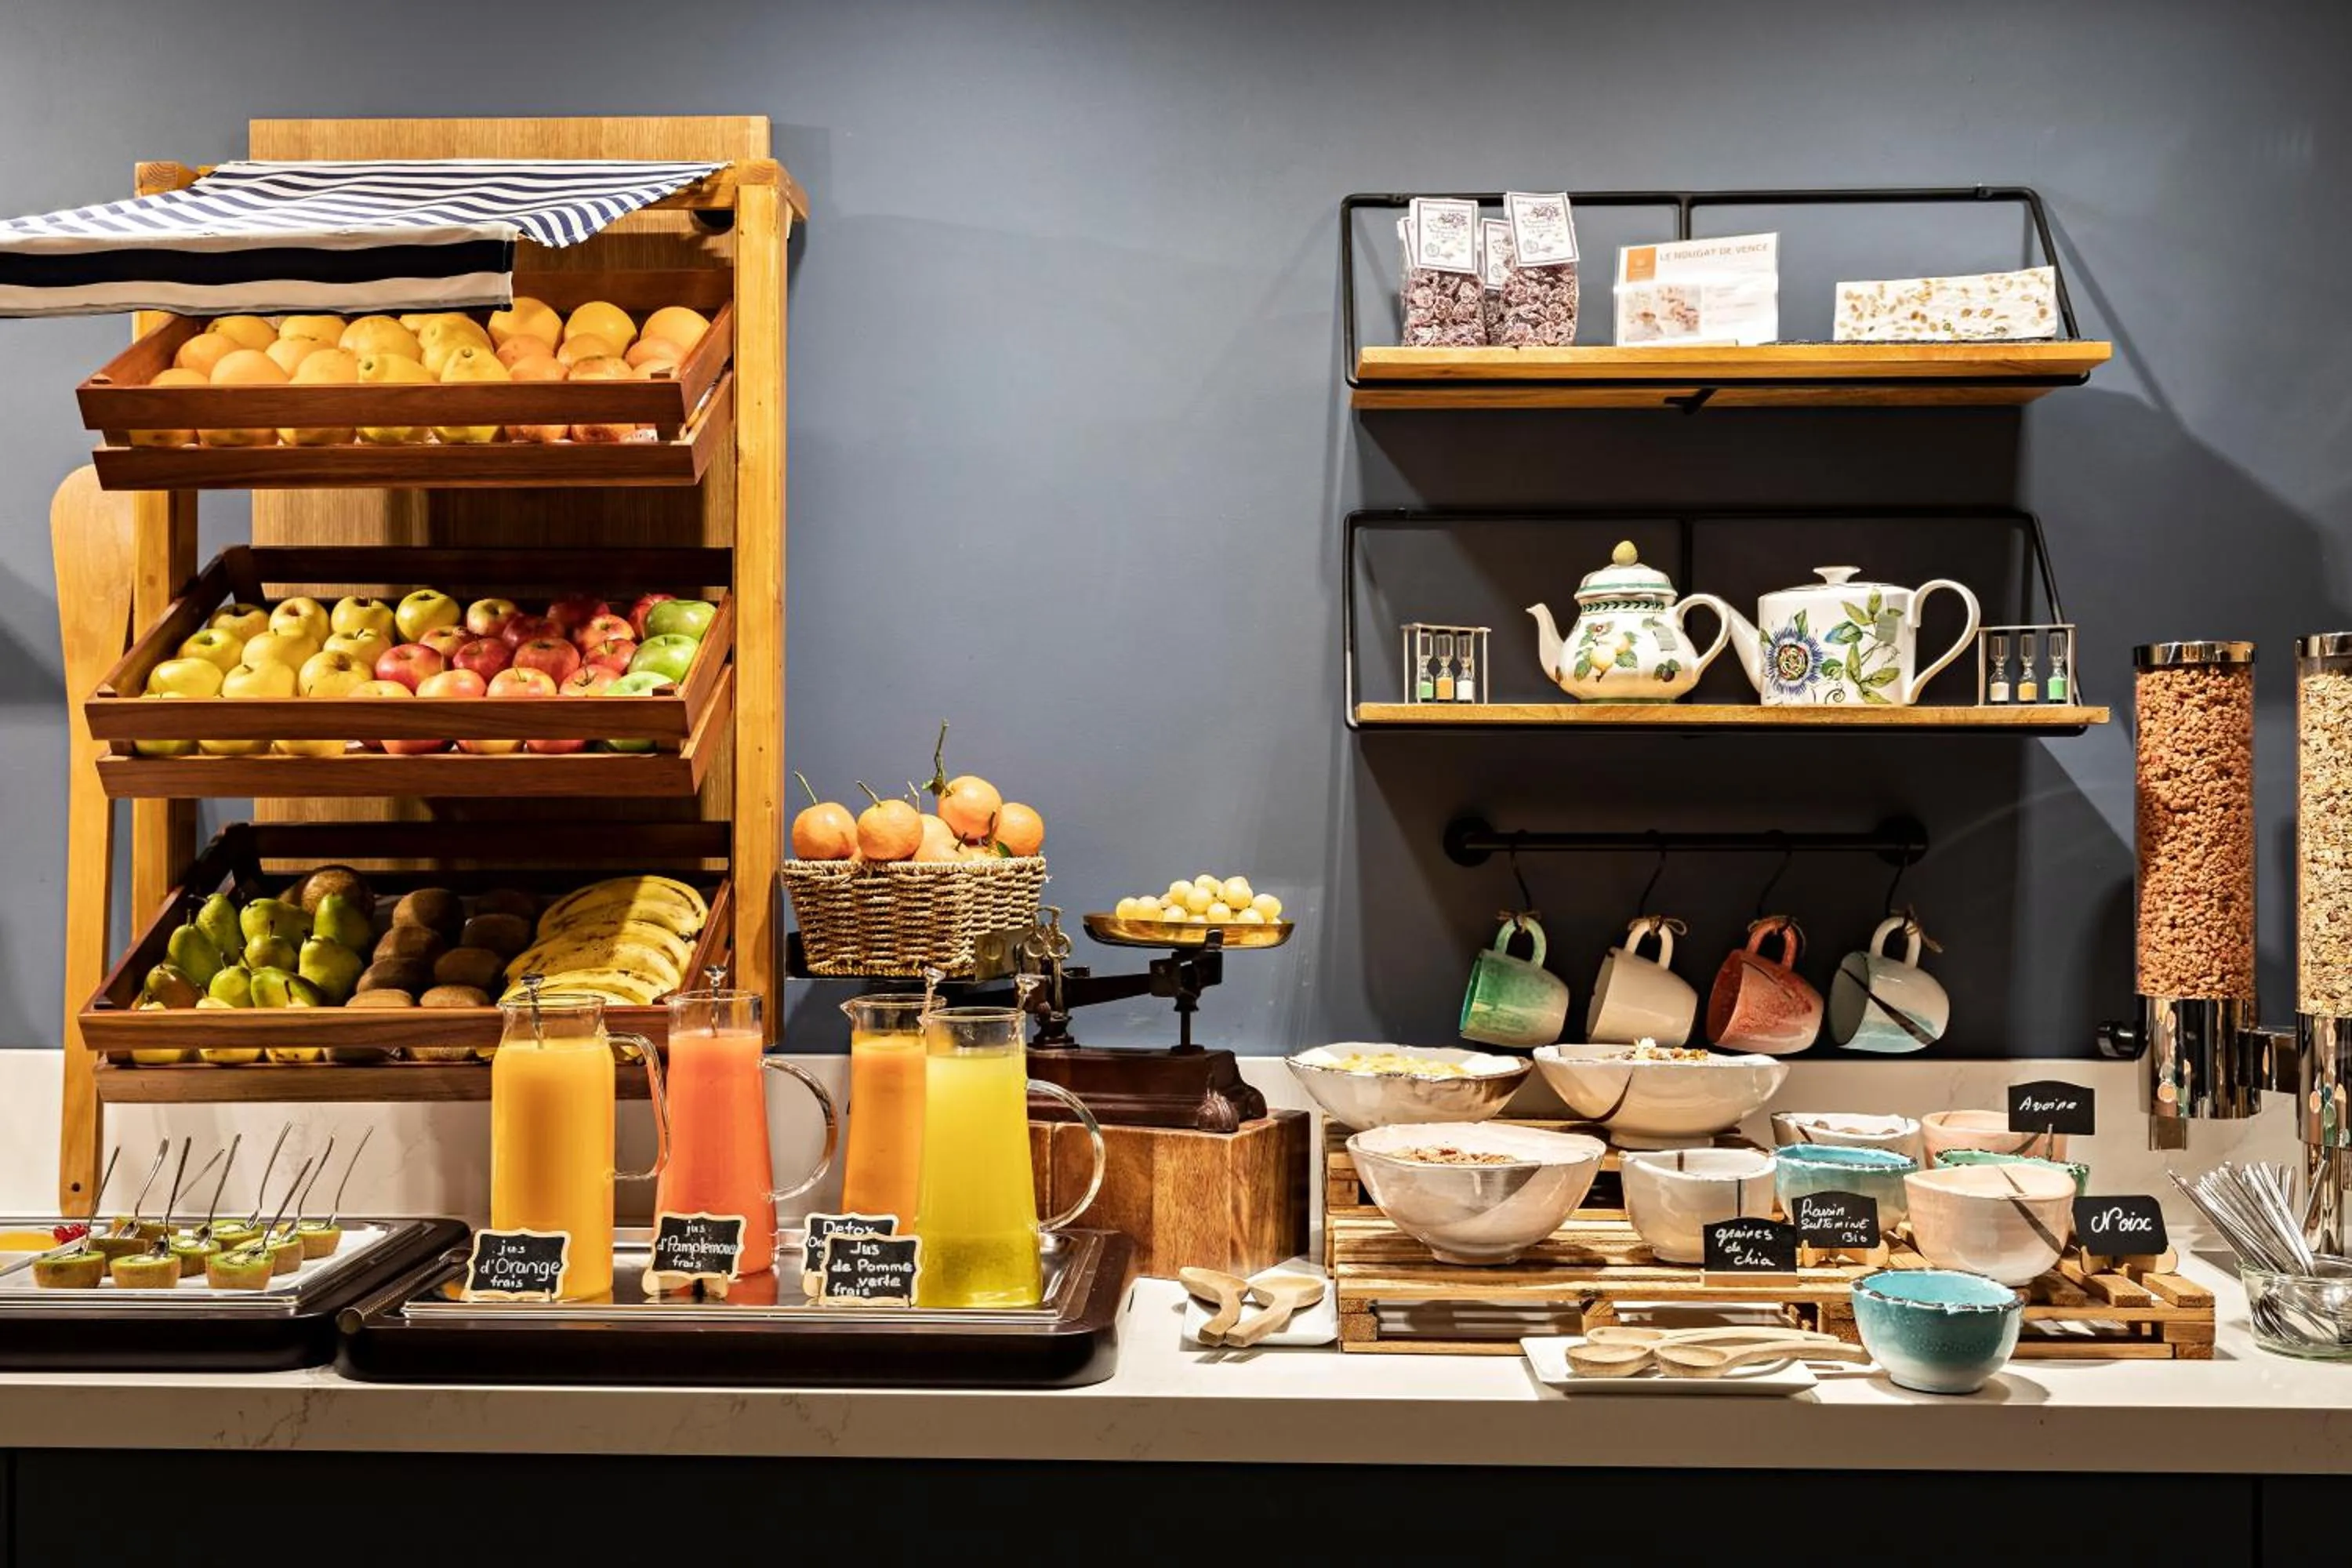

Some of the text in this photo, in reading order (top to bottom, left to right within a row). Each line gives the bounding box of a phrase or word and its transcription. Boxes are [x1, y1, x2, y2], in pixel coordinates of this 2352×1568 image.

[1674, 248, 1717, 260] NOUGAT
[1735, 243, 1769, 255] VENCE
[2019, 1096, 2078, 1112] Avoine
[686, 1220, 706, 1236] jus
[2090, 1207, 2153, 1233] Noix
[823, 1221, 876, 1236] Detox
[497, 1240, 526, 1256] jus
[1733, 1248, 1776, 1266] chia
[480, 1258, 561, 1282] d'Orange
[831, 1258, 913, 1273] de Pomme
[490, 1274, 524, 1288] frais
[858, 1274, 901, 1287] verte
[833, 1282, 871, 1296] frais
